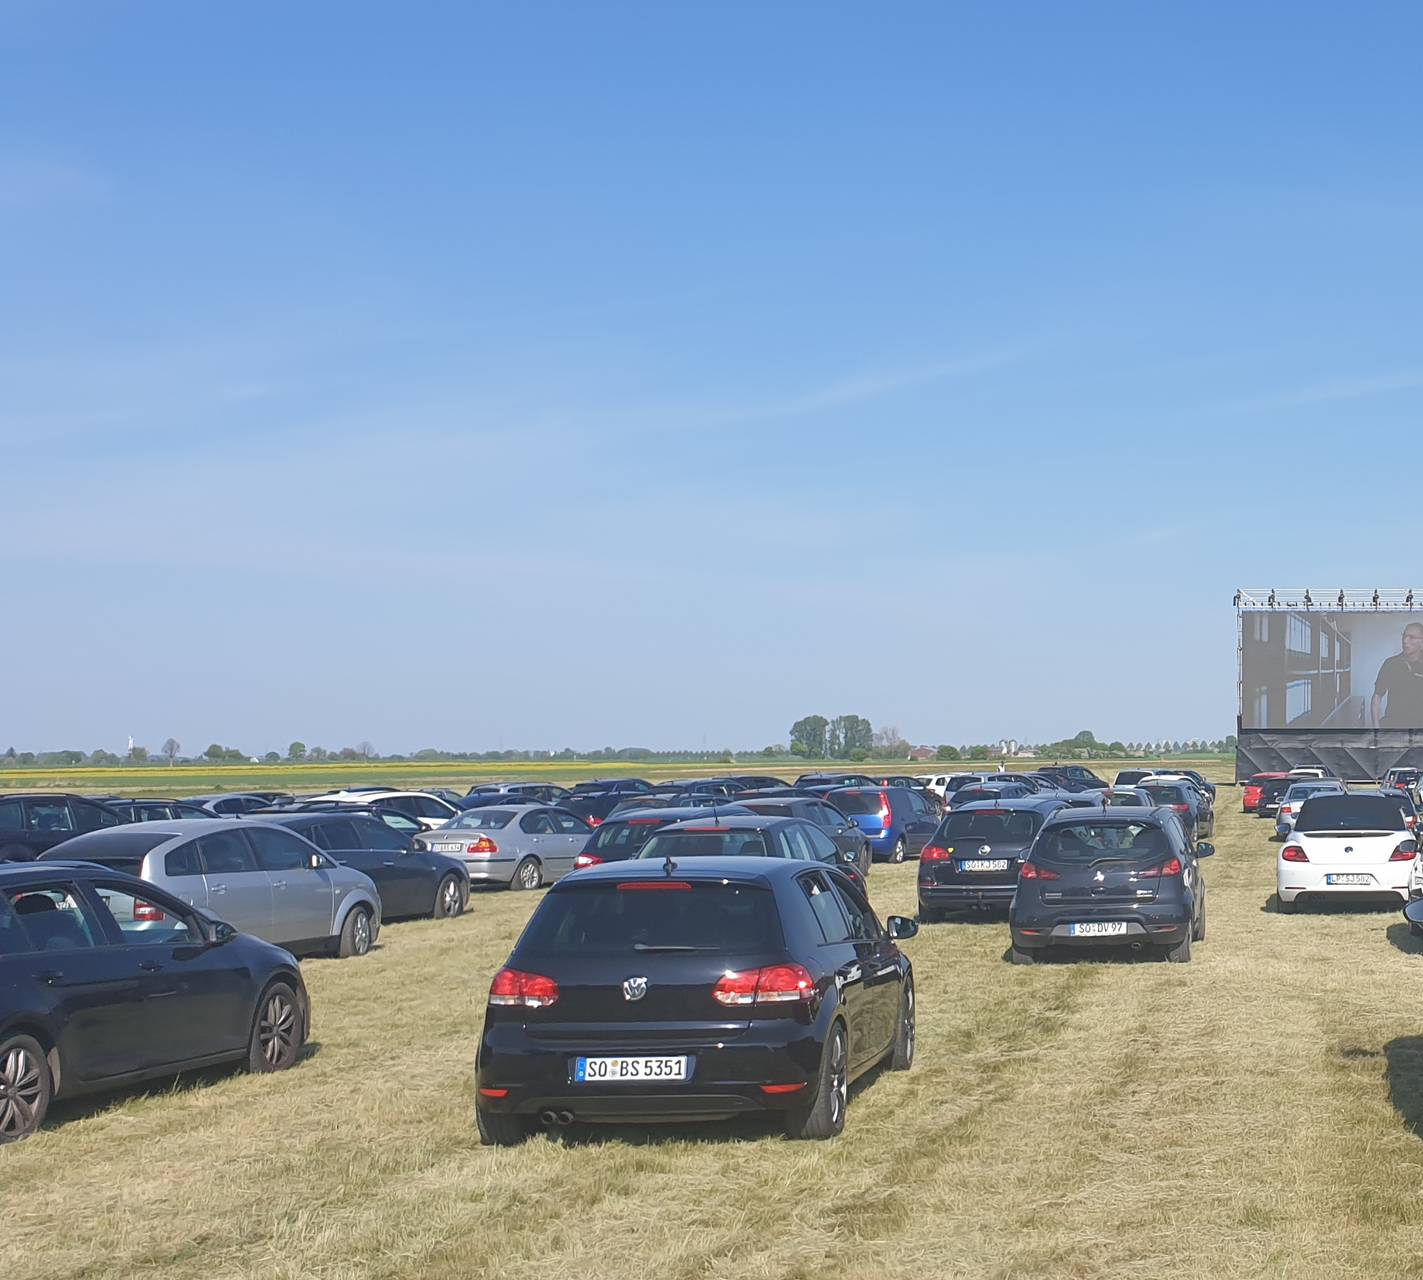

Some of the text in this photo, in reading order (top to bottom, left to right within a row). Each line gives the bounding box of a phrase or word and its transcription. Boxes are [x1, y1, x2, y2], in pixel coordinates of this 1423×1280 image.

[966, 860, 977, 869] SO
[1079, 922, 1092, 933] SO
[1097, 922, 1109, 933] DV
[587, 1061, 608, 1077] SO
[620, 1060, 640, 1077] BS
[644, 1059, 683, 1076] 5351
